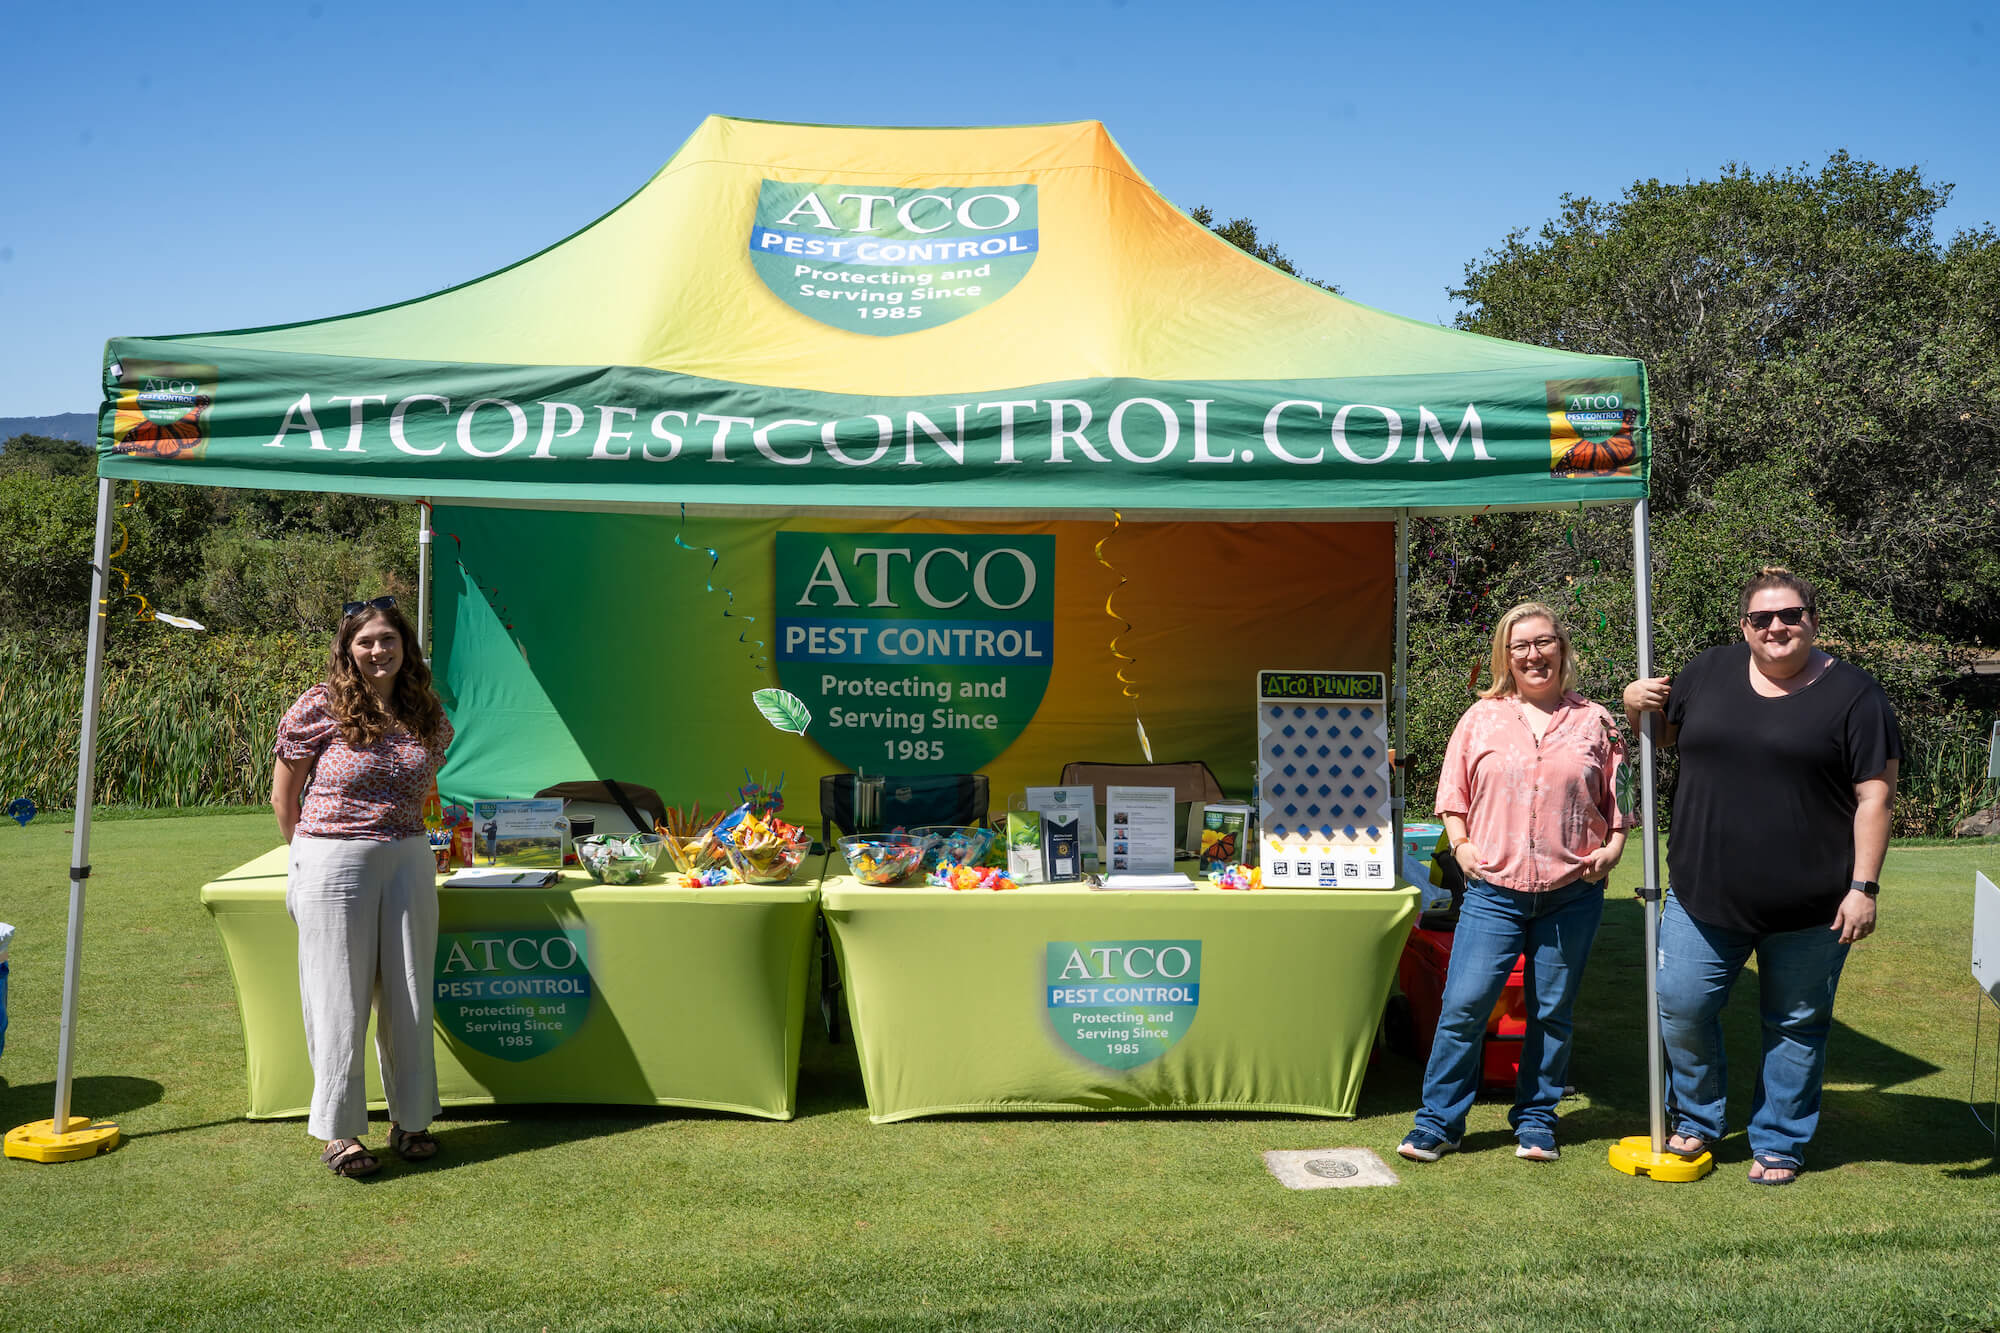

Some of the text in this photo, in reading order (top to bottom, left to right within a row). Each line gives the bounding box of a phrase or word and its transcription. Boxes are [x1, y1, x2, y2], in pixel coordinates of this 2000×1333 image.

[776, 192, 1022, 234] ATCO
[760, 232, 1027, 261] PEST CONTROL
[794, 263, 991, 285] Protecting and
[799, 284, 982, 305] Serving Since
[857, 306, 922, 319] 1985
[145, 379, 195, 394] ATCO
[1570, 395, 1619, 410] ATCO
[262, 392, 1496, 466] ATCOPESTCONTROL.COM
[795, 545, 1037, 610] ATCO
[785, 626, 1043, 658] PEST CONTROL
[821, 675, 1007, 703] Protecting and
[828, 707, 999, 734] Serving Since
[884, 740, 945, 761] 1985
[442, 937, 577, 973] ATCO
[1058, 946, 1192, 980] ATCO
[438, 979, 585, 998] PEST CONTROL
[1052, 987, 1194, 1005] PEST CONTROL
[460, 1003, 566, 1018] Protecting and
[1072, 1011, 1174, 1025] Protecting and
[465, 1019, 563, 1034] Serving Since
[1076, 1027, 1169, 1041] Serving Since
[498, 1036, 534, 1047] 1985
[1106, 1044, 1140, 1055] 1985
